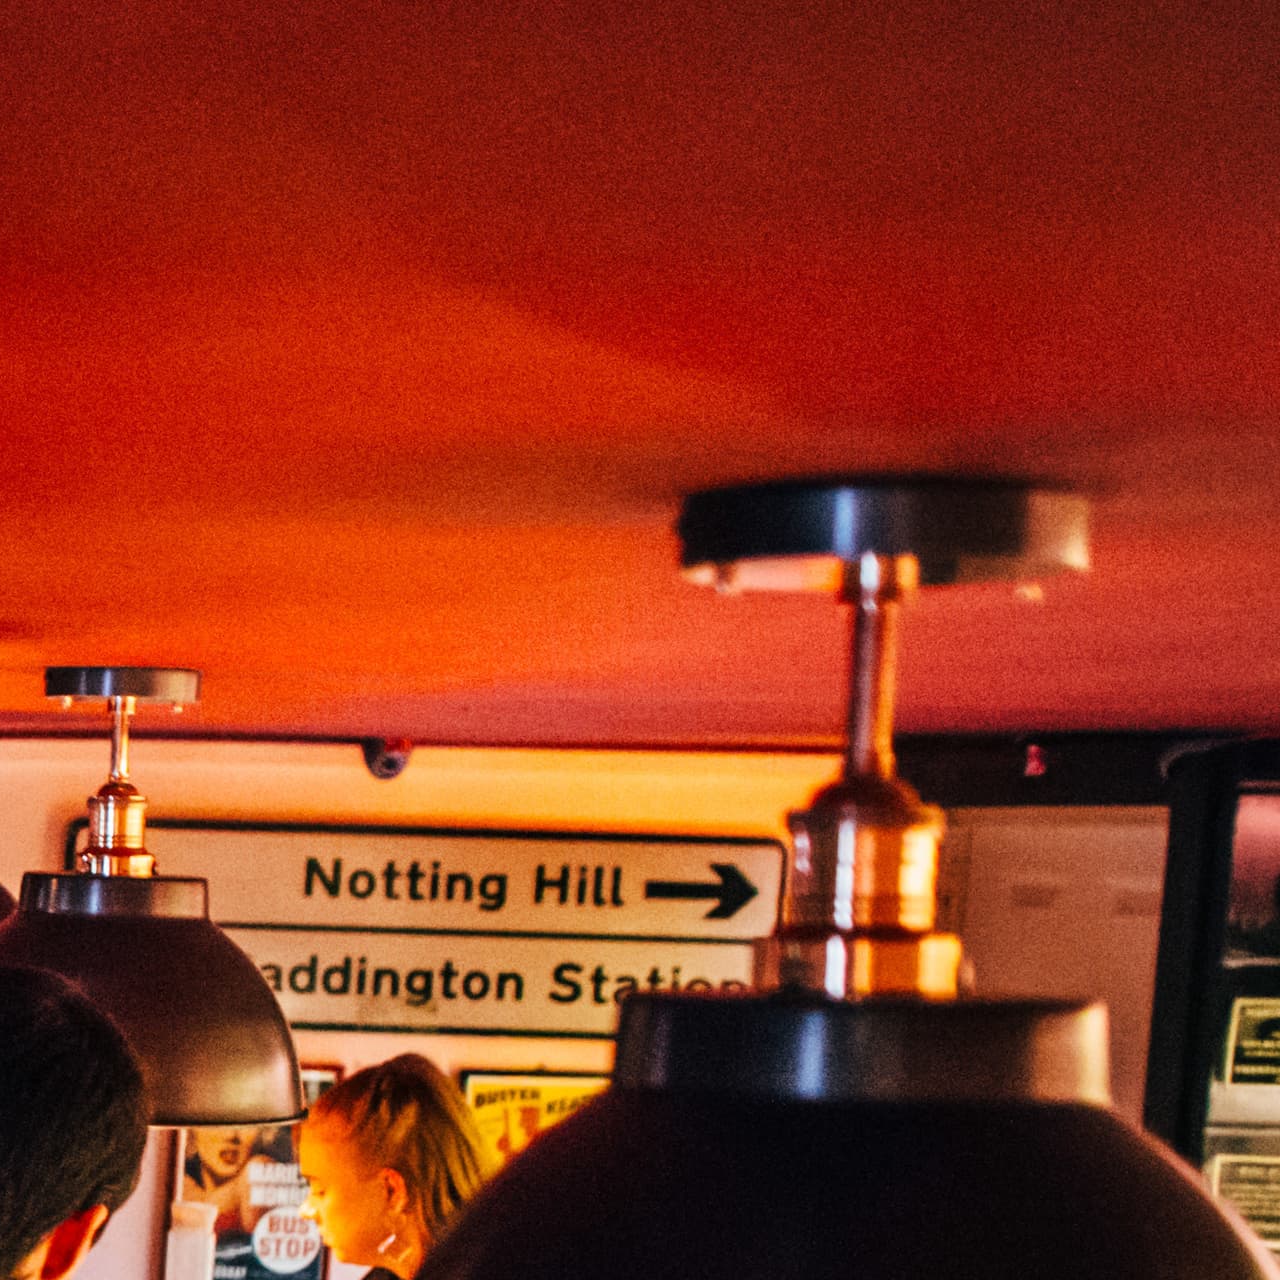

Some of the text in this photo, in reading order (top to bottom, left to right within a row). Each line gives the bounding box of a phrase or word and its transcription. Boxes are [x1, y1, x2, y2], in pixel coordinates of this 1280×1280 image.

[304, 857, 623, 911] Notting Hill
[260, 954, 525, 1006] addington
[268, 1216, 309, 1234] BUS
[259, 1238, 316, 1257] STOP
